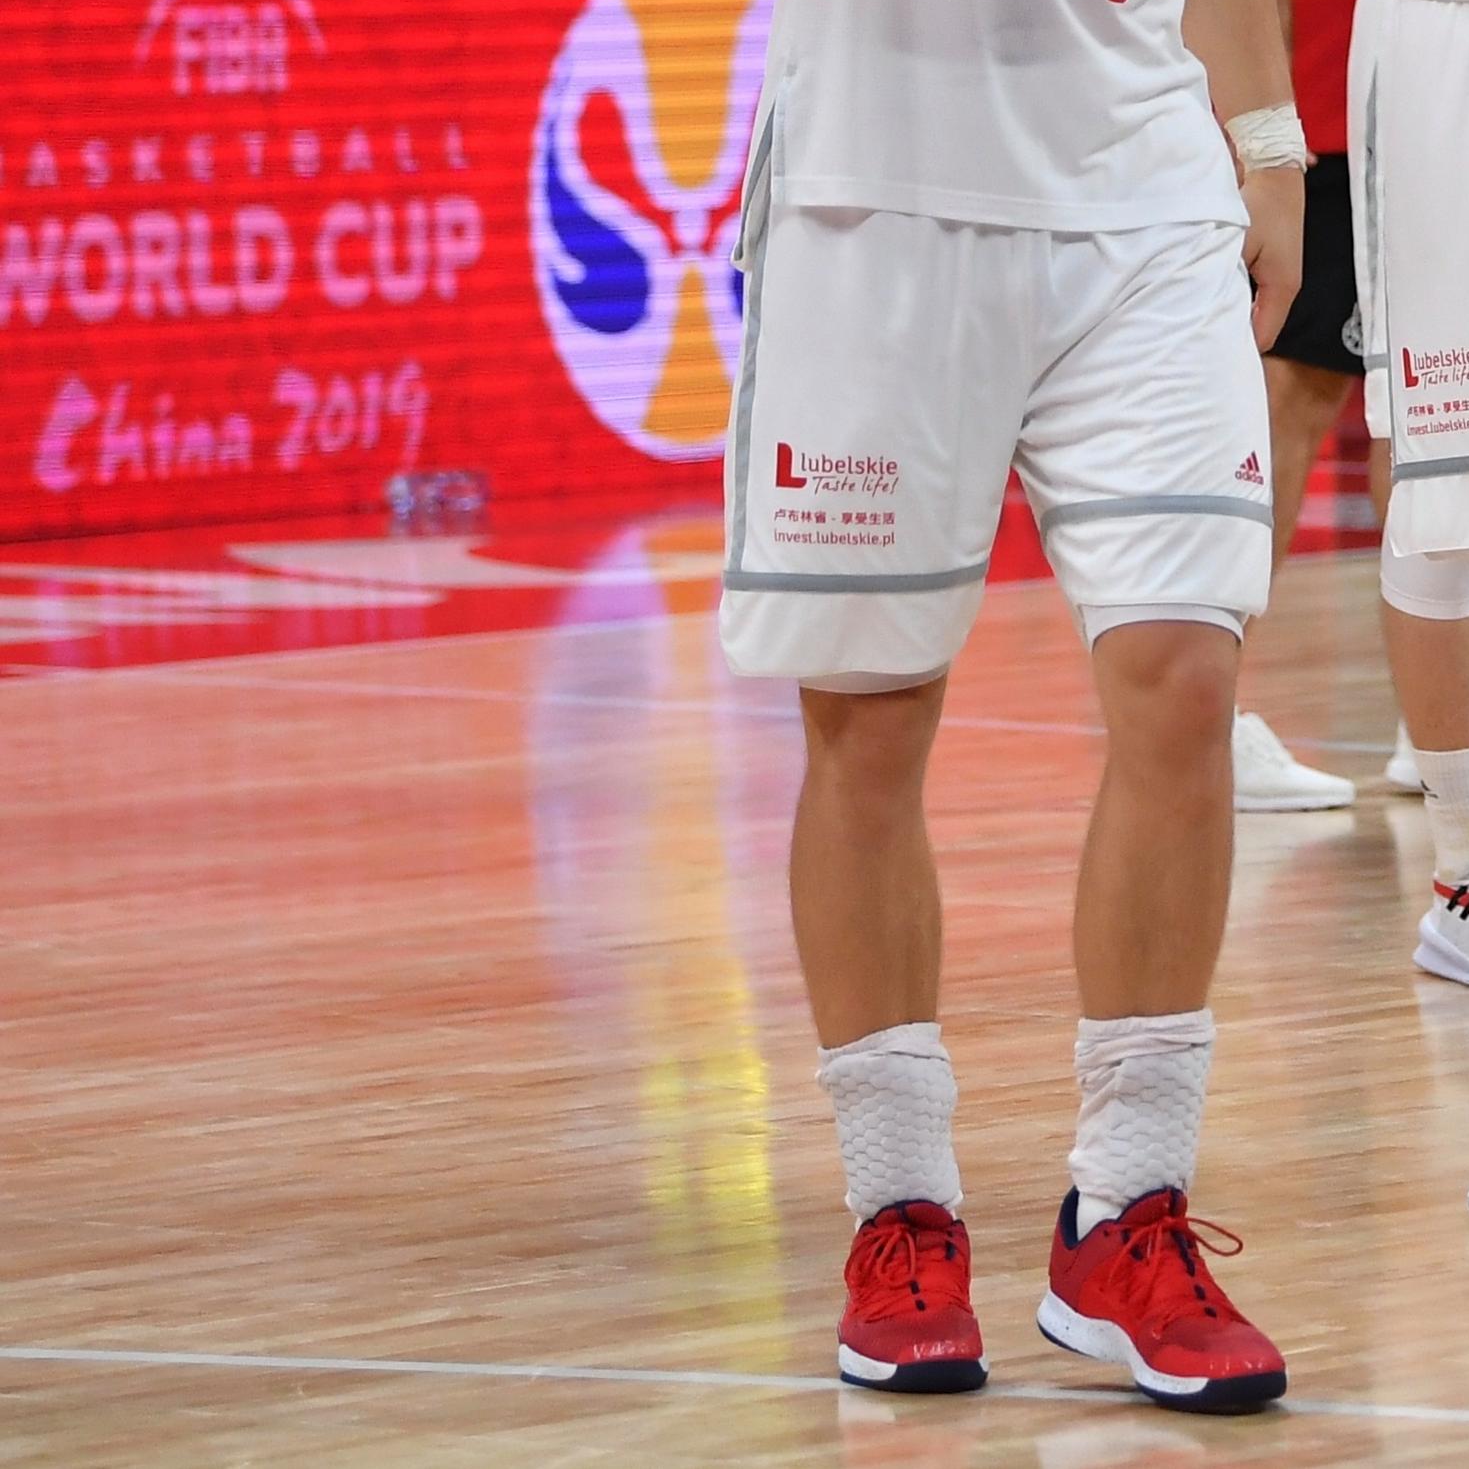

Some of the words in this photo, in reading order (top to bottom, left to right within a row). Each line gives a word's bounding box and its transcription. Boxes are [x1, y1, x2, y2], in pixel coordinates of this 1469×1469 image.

[173, 3, 288, 96] FIBA
[0, 125, 470, 186] ASKETBALL
[314, 196, 485, 307] CUP
[34, 377, 252, 488] China
[275, 362, 430, 470] 2019
[812, 475, 856, 495] Taste
[861, 476, 899, 498] life!
[773, 528, 896, 548] invest.lubelskie.pl
